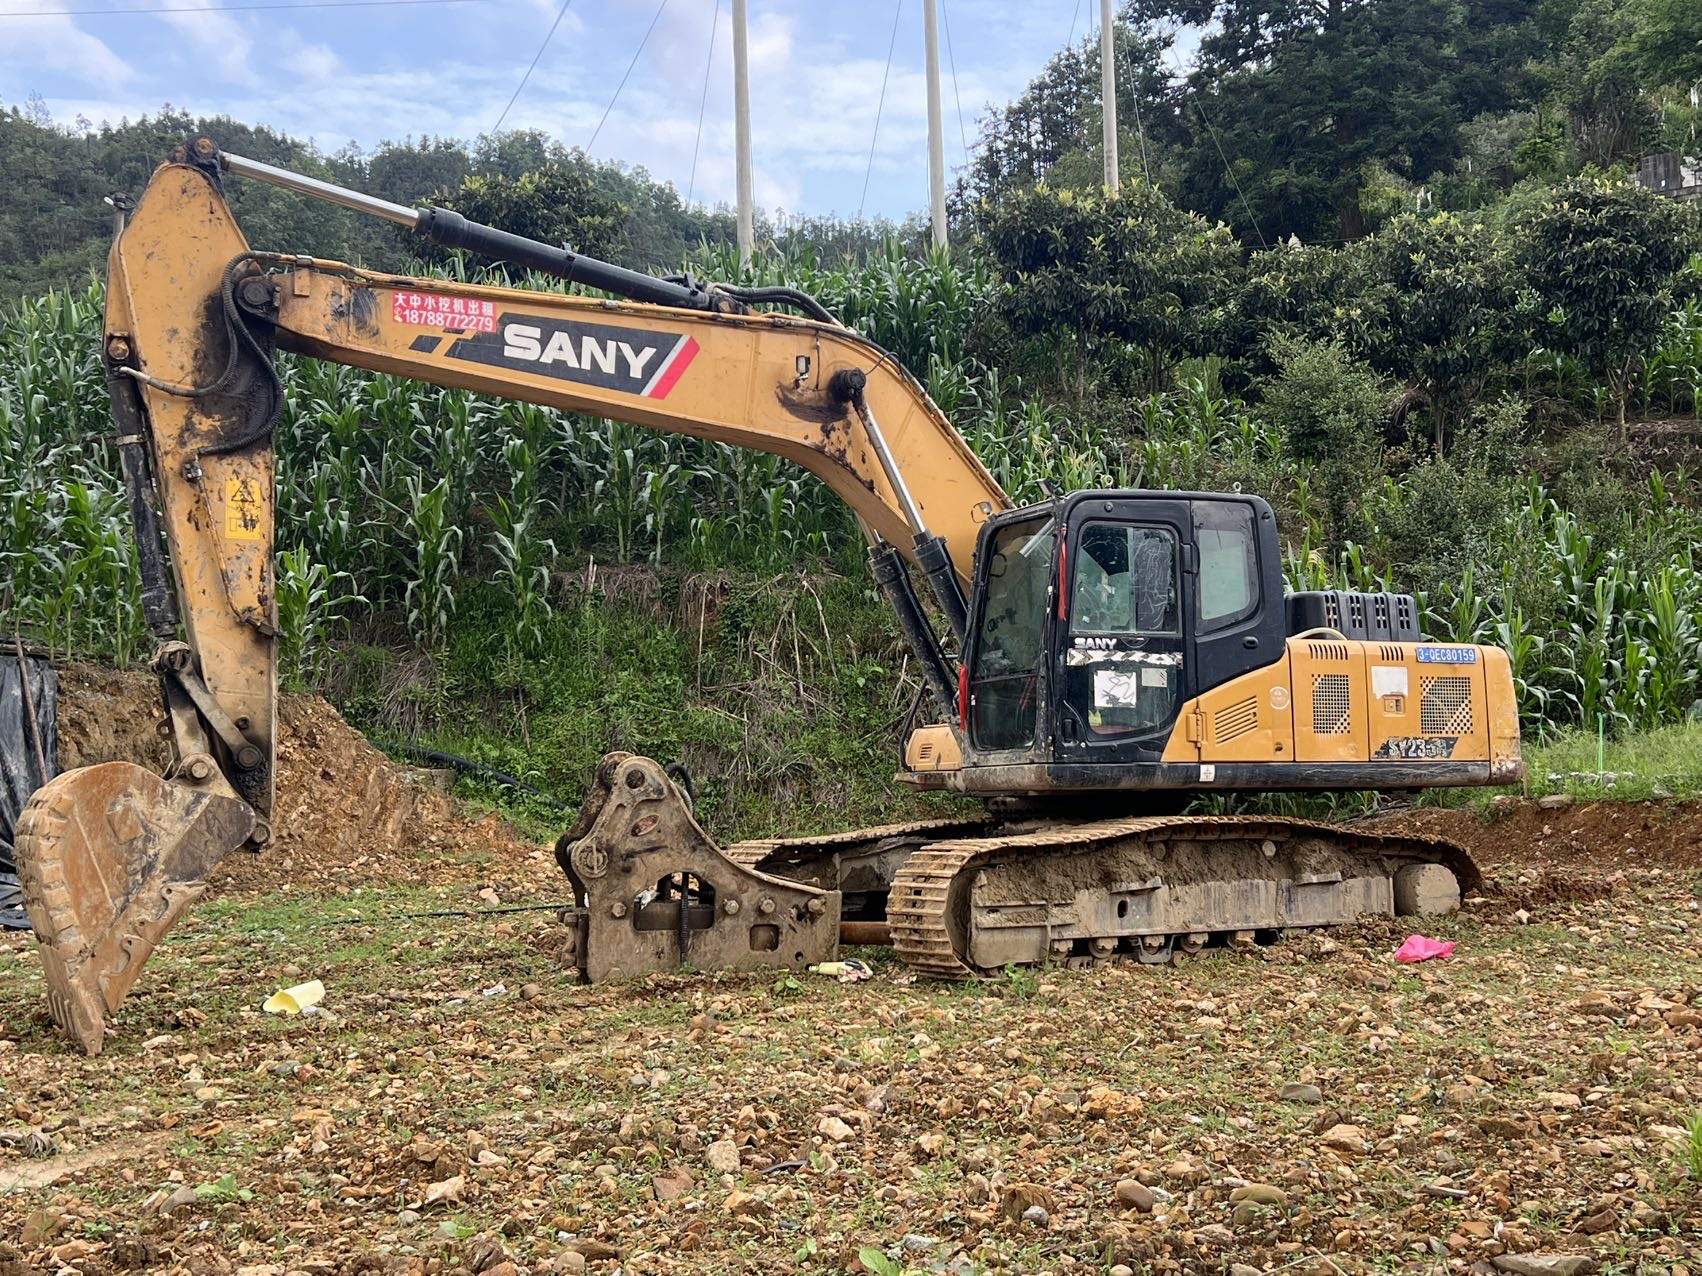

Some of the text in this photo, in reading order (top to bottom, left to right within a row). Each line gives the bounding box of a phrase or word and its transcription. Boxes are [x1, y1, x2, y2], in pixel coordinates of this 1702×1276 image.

[394, 292, 494, 316] 大中小挖机出租
[403, 309, 493, 331] 18788772279
[503, 323, 656, 379] SANY
[1074, 637, 1117, 650] SANY
